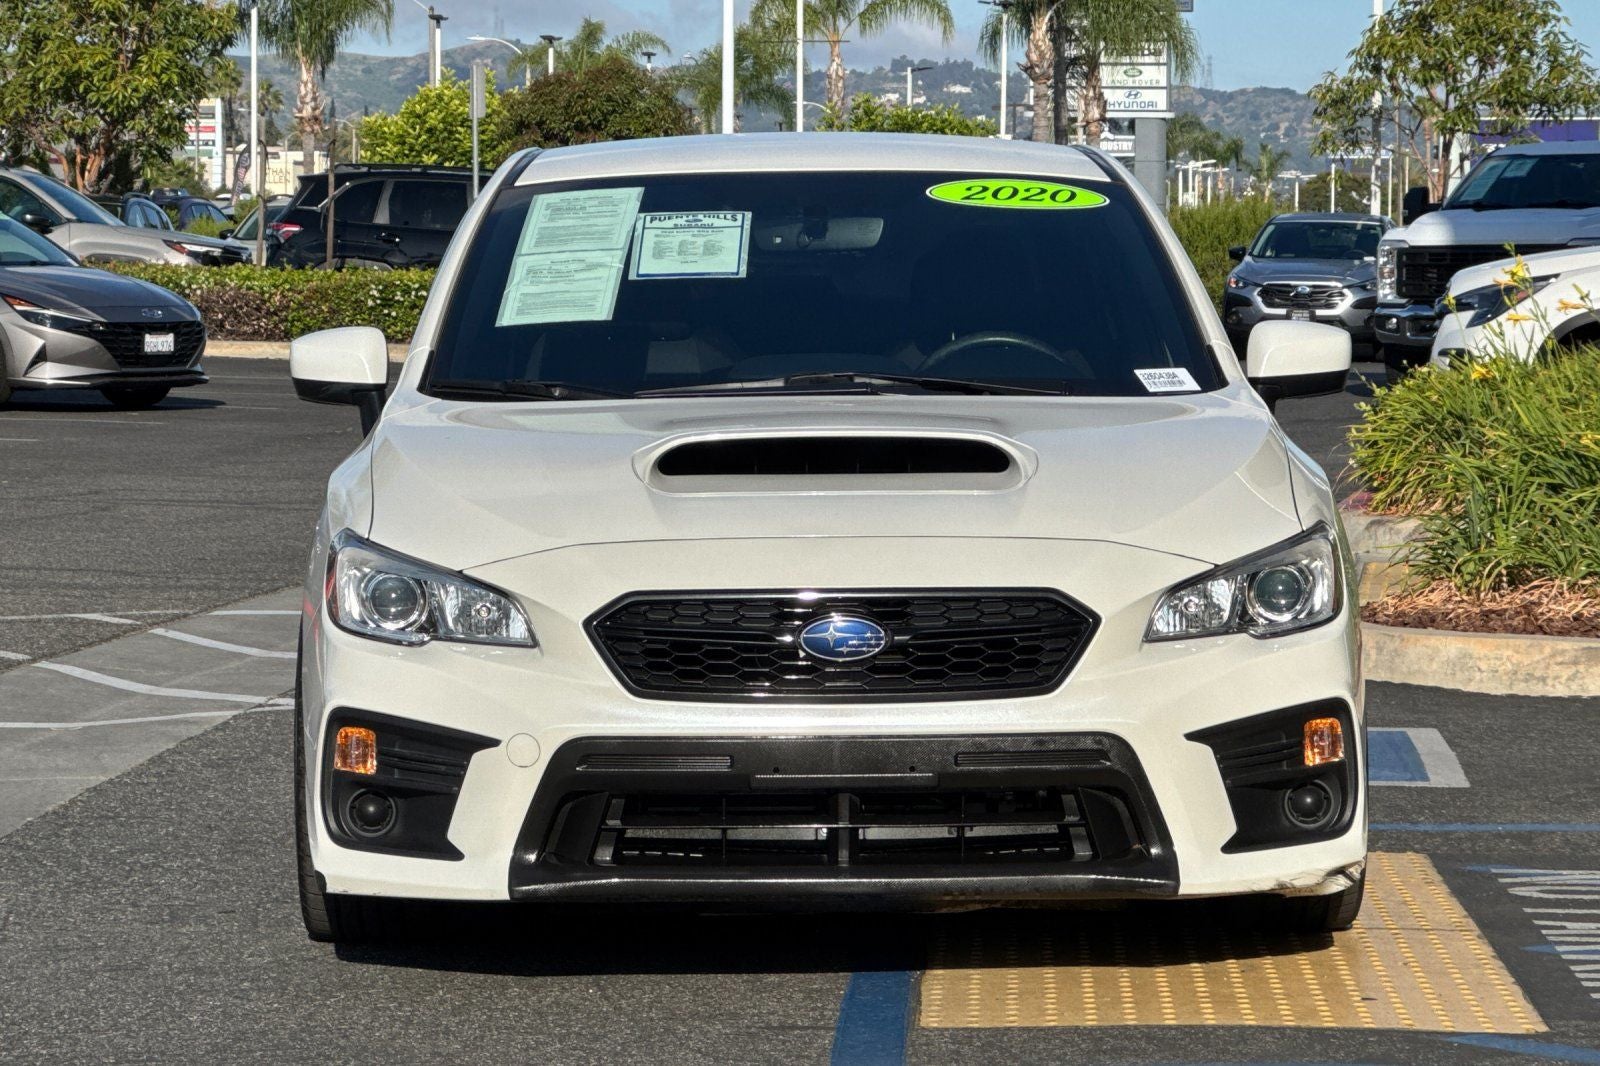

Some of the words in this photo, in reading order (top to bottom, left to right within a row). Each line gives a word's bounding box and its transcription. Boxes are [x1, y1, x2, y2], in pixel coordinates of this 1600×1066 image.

[1108, 100, 1158, 109] HYUNDAI
[961, 185, 1077, 203] 2020
[649, 214, 698, 225] PUENTE
[701, 213, 739, 222] HILLS
